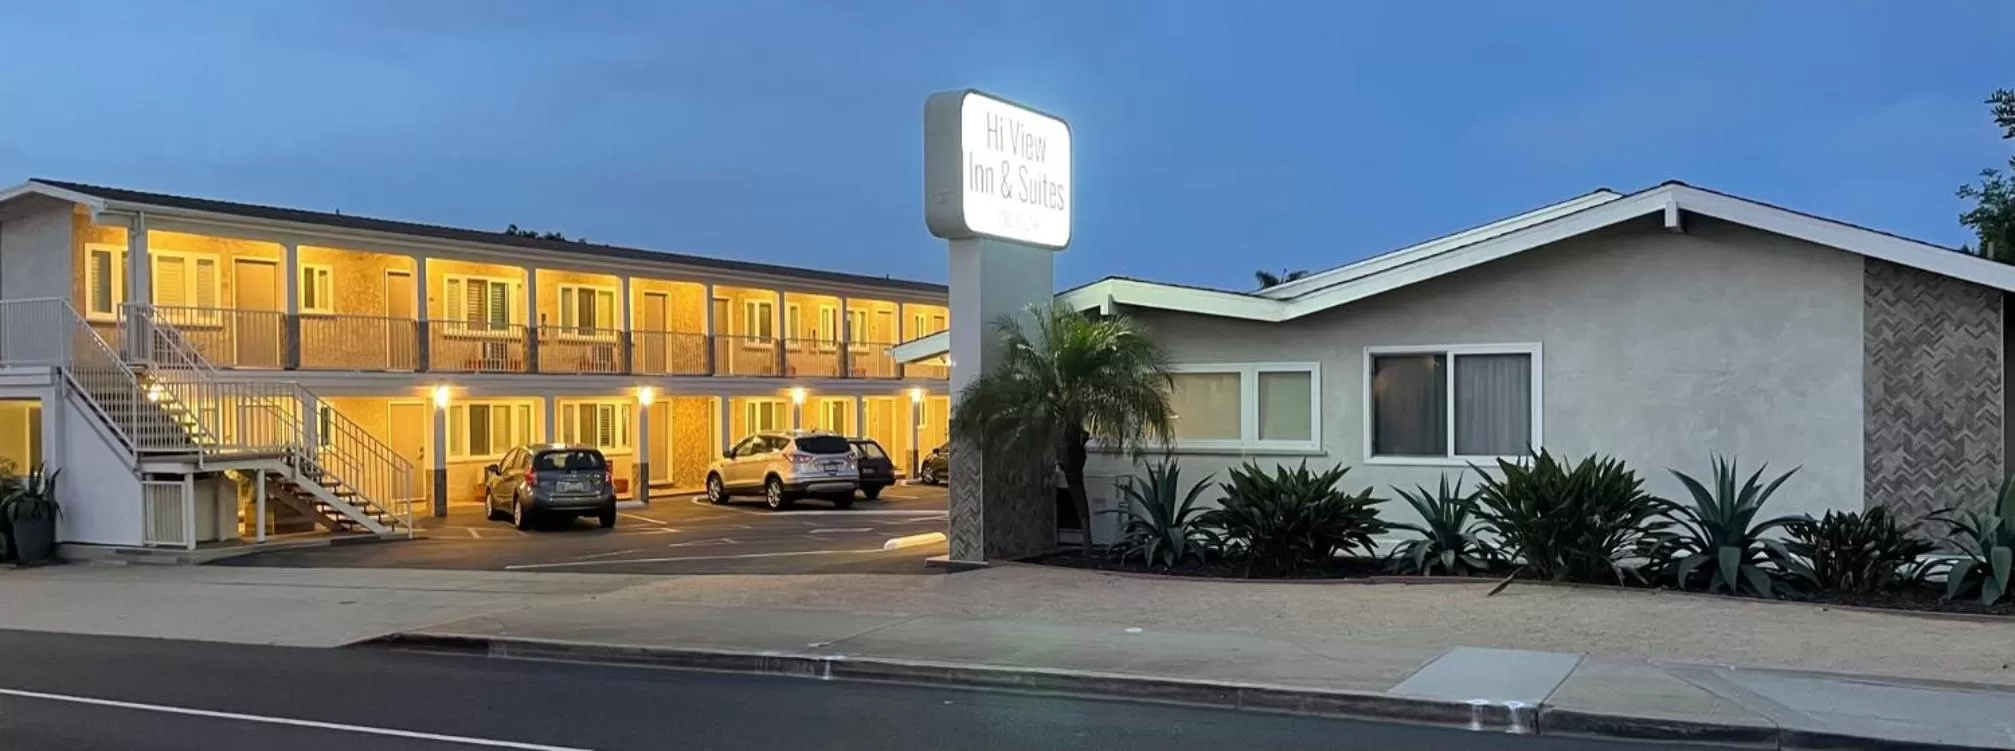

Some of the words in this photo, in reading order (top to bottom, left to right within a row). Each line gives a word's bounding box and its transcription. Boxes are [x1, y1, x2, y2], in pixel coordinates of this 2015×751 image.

[986, 111, 1005, 152] Hi
[1008, 117, 1048, 163] View
[969, 150, 995, 195] Inn
[1000, 160, 1013, 200] &
[1018, 164, 1065, 211] Suites
